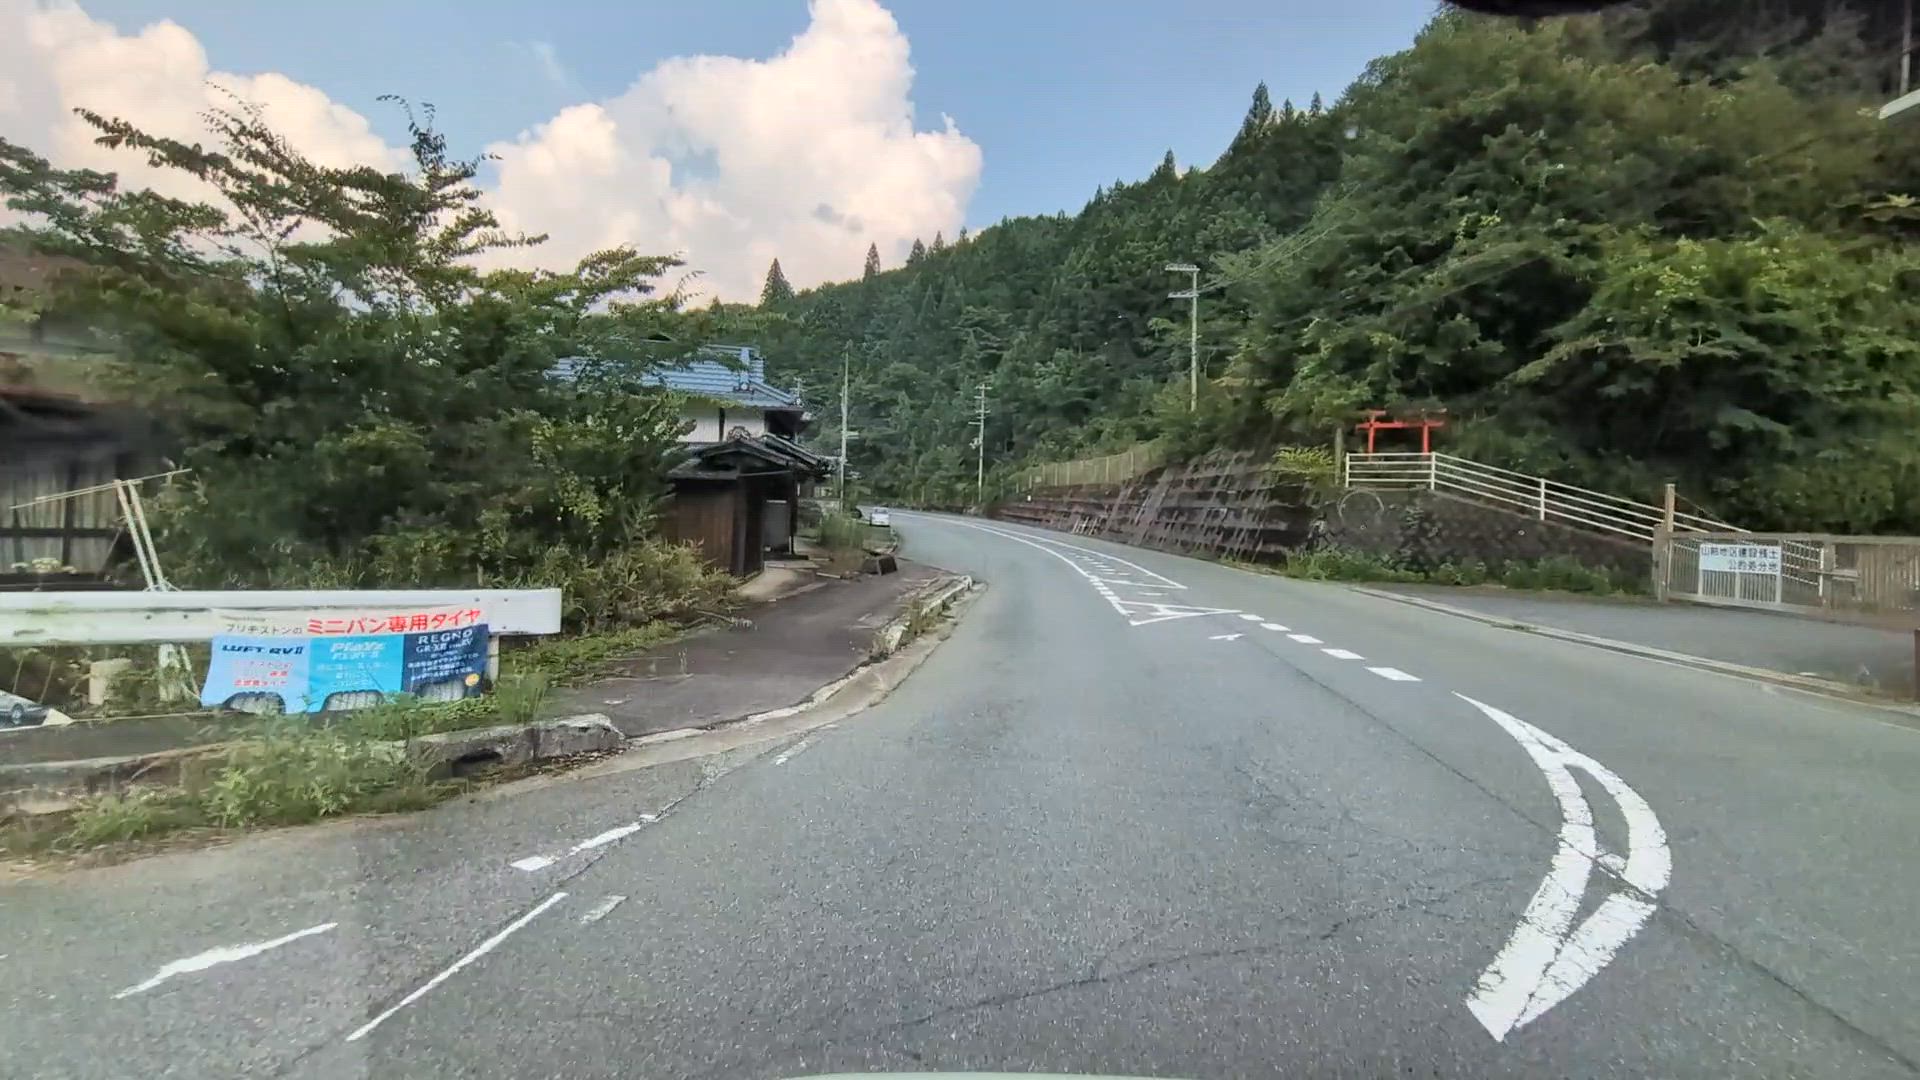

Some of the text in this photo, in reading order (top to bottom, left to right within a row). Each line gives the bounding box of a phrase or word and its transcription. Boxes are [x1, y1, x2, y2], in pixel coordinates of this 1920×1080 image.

[307, 609, 481, 635] ミニバン専用タイヤ
[417, 628, 473, 645] REGNO
